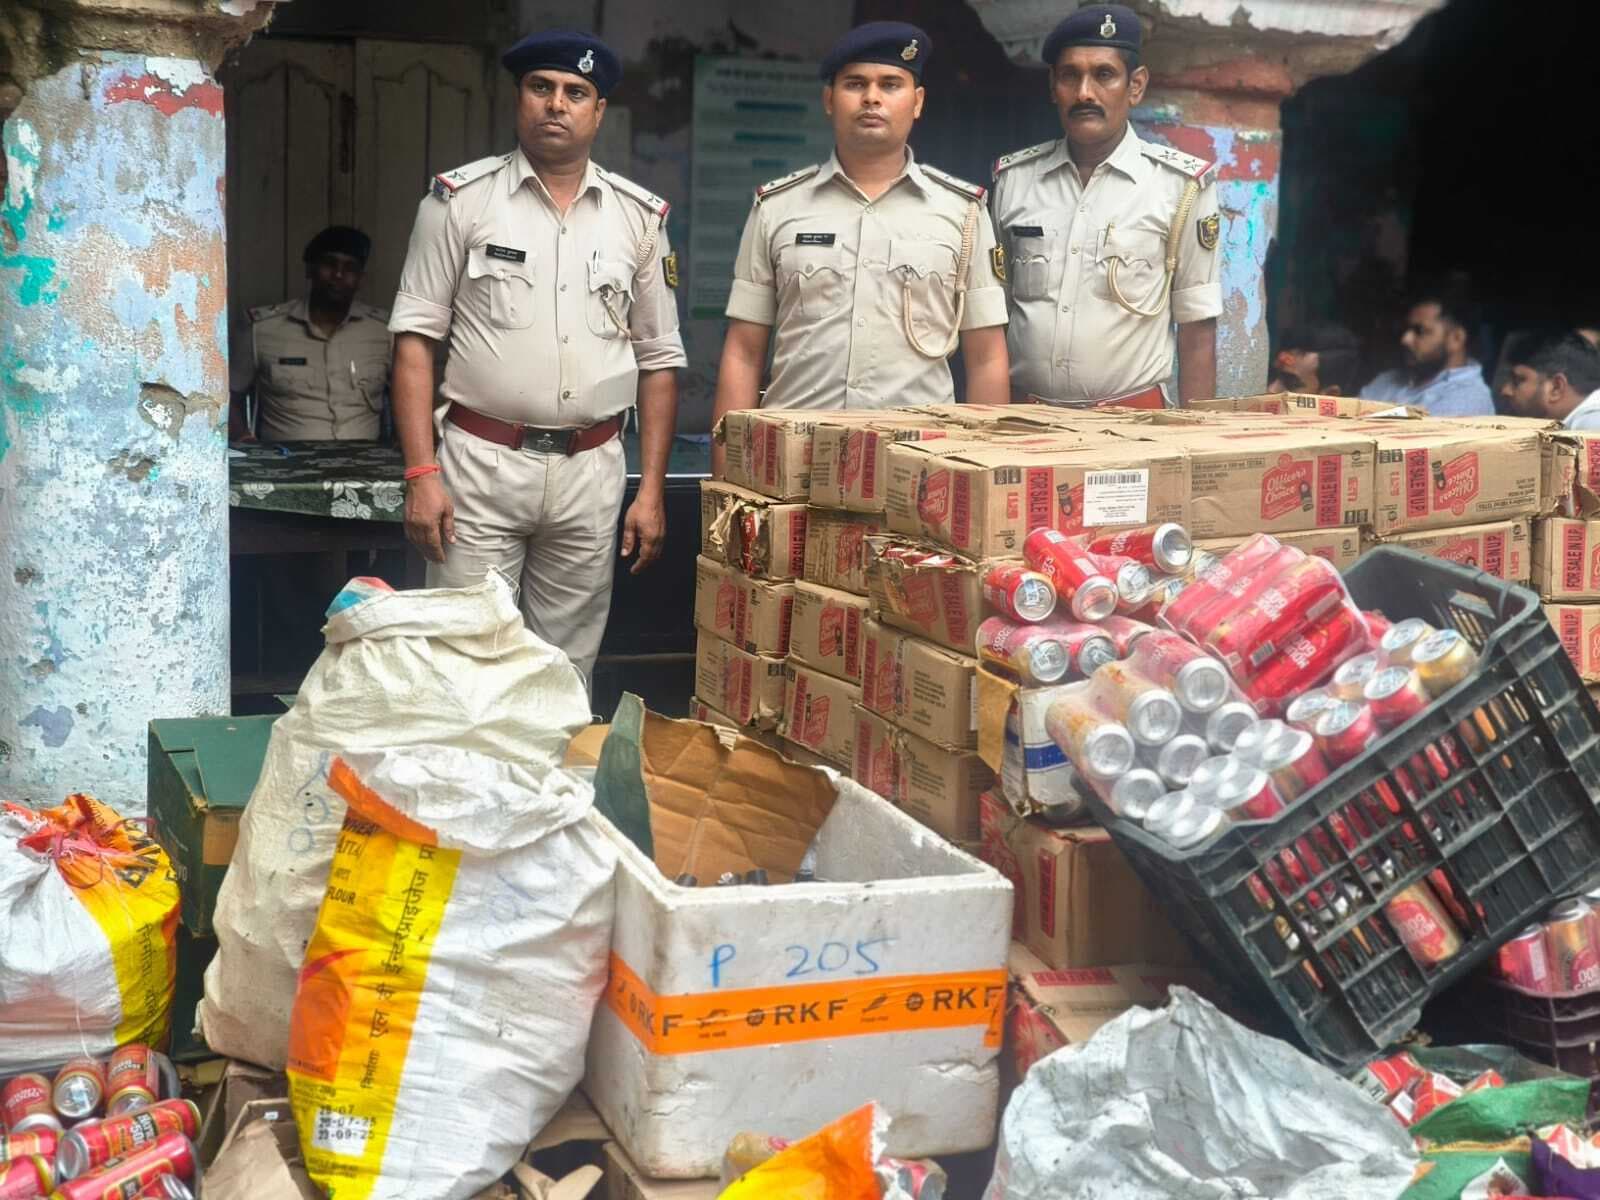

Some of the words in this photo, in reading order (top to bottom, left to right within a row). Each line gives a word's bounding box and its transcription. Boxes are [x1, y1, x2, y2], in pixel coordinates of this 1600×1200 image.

[1410, 450, 1425, 466] FOR
[1030, 472, 1048, 489] FOR
[1410, 467, 1425, 488] SALE
[1030, 490, 1048, 512] SALE
[1319, 484, 1337, 505] SALE
[1319, 507, 1337, 522] FOR
[1567, 542, 1582, 550] IN
[1567, 551, 1582, 571] SALE
[1566, 572, 1581, 588] FOR
[1564, 636, 1579, 656] SALE
[327, 886, 356, 905] FLOUR
[708, 944, 737, 988] P
[786, 936, 896, 977] 205
